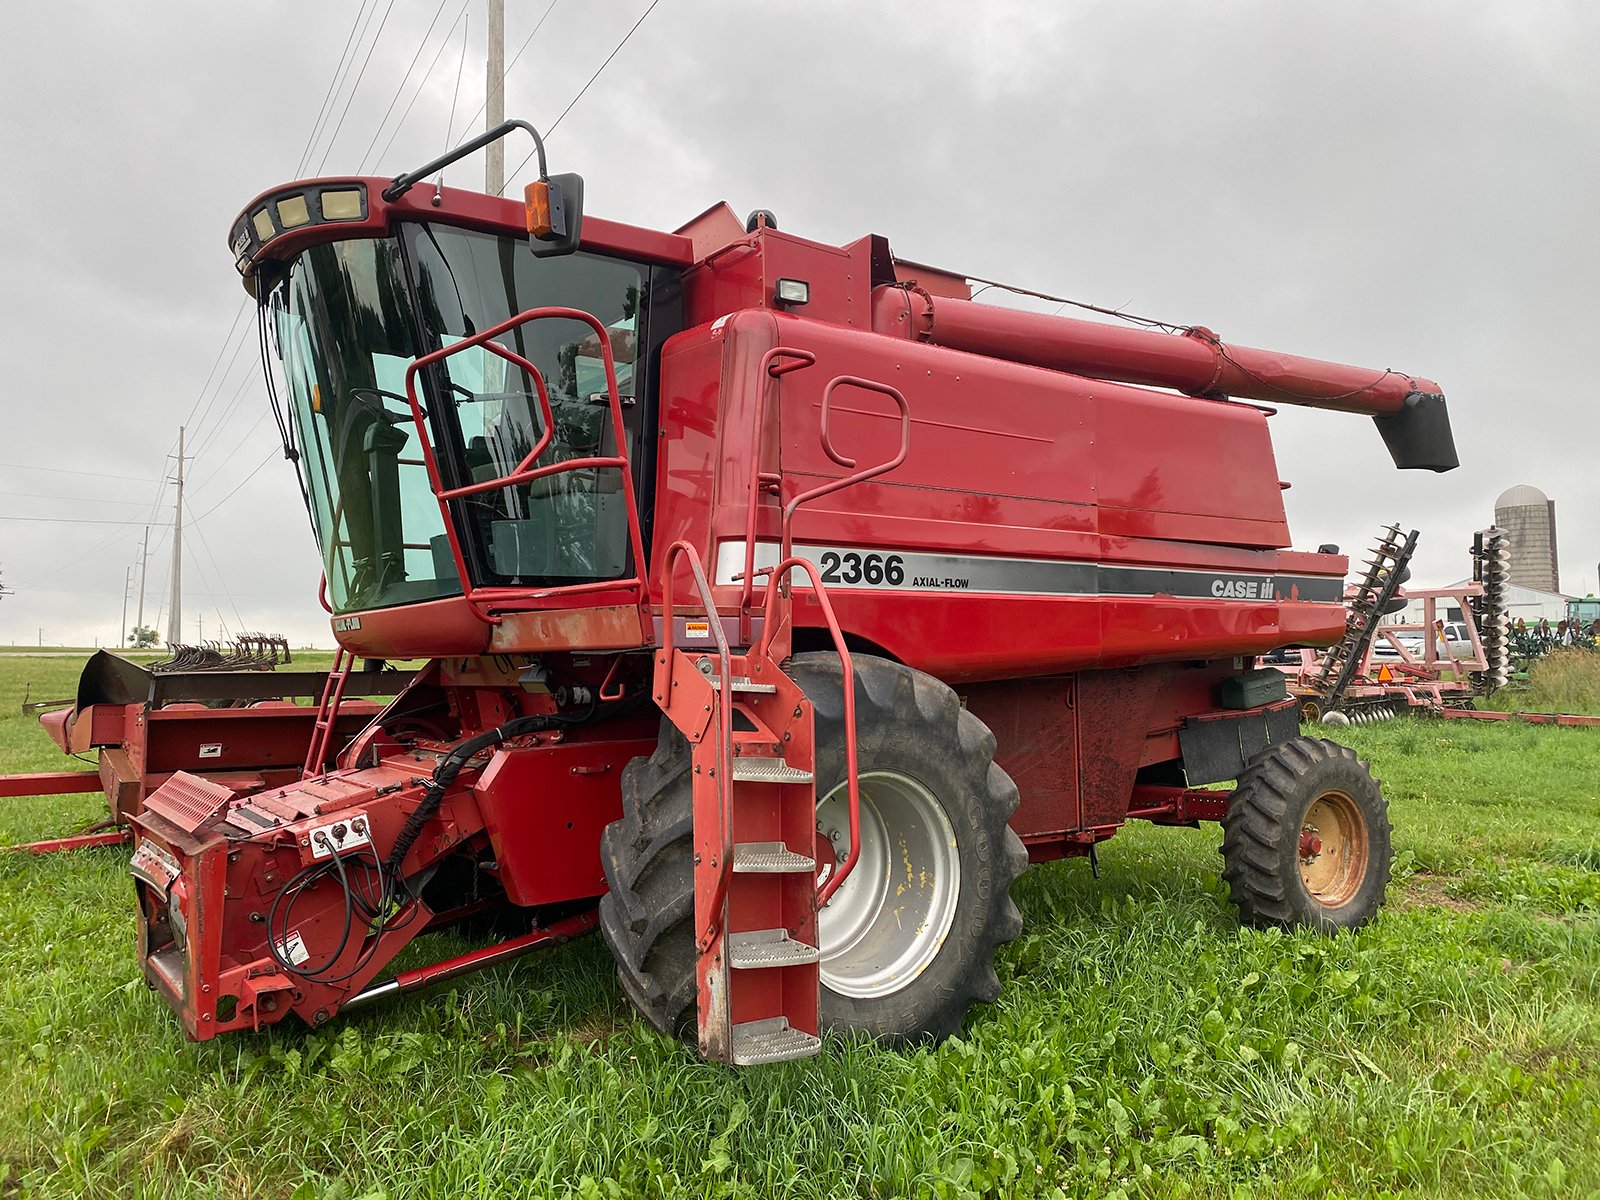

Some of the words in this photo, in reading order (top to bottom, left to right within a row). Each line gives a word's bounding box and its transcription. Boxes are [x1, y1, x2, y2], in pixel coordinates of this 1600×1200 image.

[820, 551, 905, 586] 2366
[912, 576, 969, 589] AXIAL-FLOW
[1211, 579, 1258, 598] CASE
